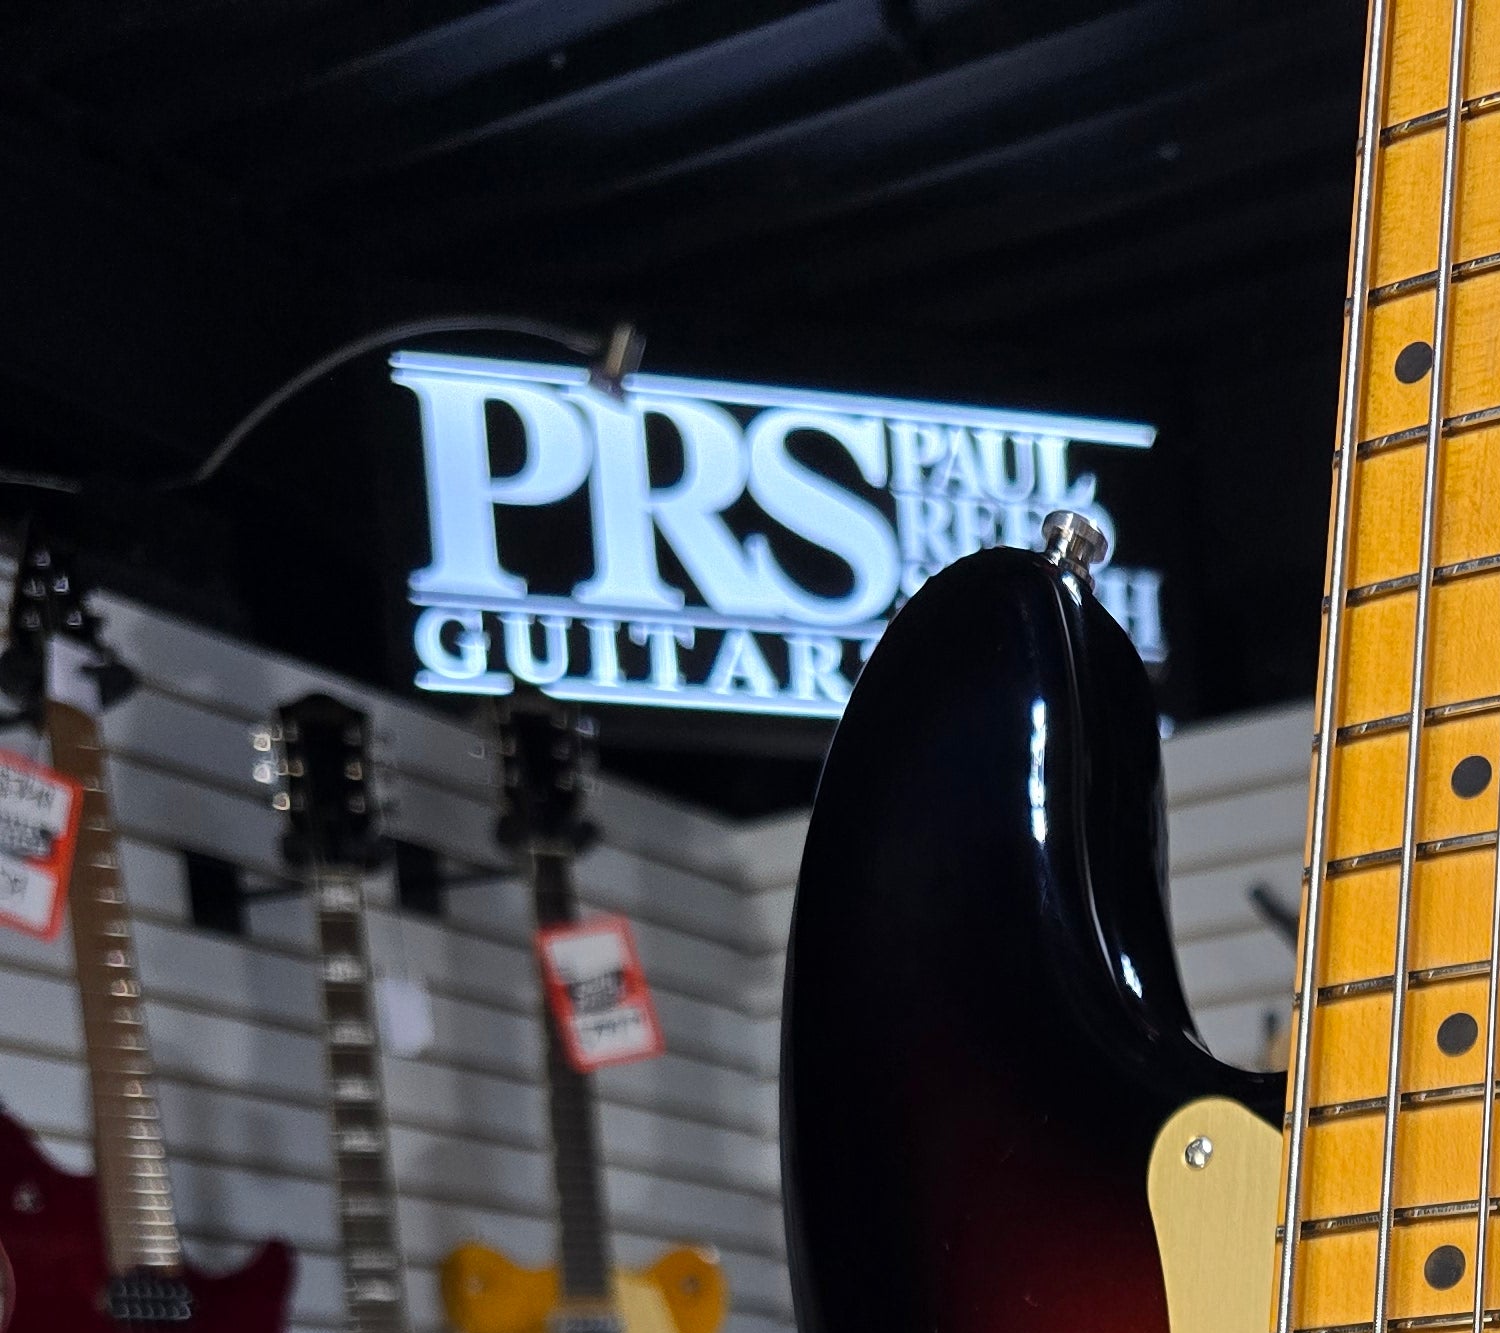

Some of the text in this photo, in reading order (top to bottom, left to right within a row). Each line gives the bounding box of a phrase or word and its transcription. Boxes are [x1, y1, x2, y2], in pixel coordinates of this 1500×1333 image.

[391, 371, 900, 628] PRS
[887, 420, 1097, 506] PAUL
[413, 607, 882, 704] GUITAR
